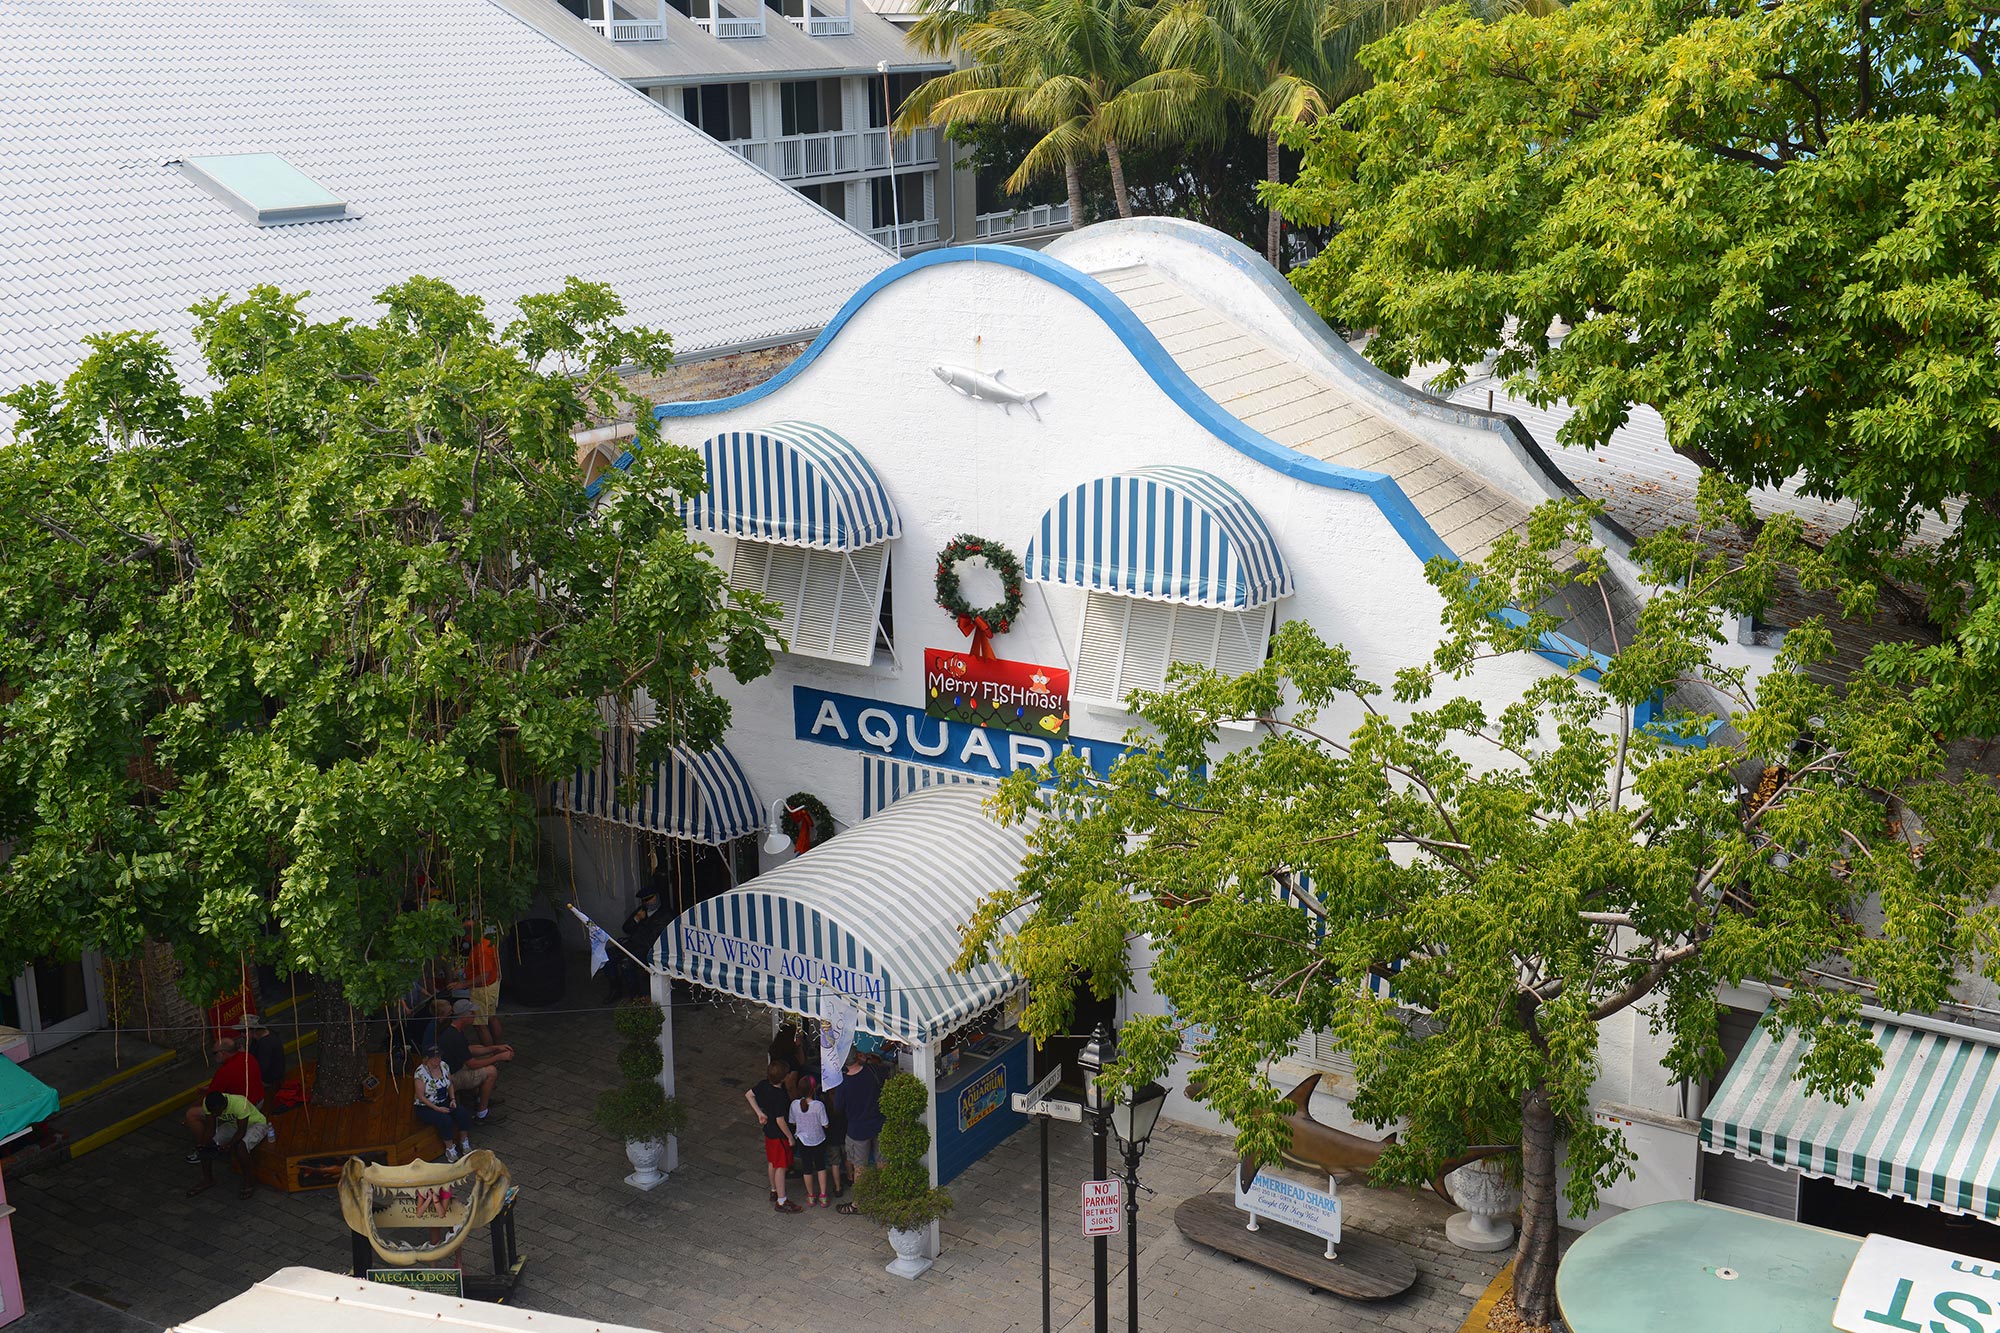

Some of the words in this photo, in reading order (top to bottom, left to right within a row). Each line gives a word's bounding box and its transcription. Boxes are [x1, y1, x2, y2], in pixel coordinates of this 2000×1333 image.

[928, 671, 980, 697] Merry
[982, 681, 1063, 711] FISHmas!
[811, 700, 1190, 798] AQUARU
[684, 927, 718, 957] KEY
[721, 937, 772, 971] WEST
[779, 953, 881, 1003] AQUARIUM
[981, 1070, 998, 1084] WEST
[961, 1072, 1005, 1112] AQUARIUM
[967, 1104, 995, 1126] TICKETS
[1040, 1102, 1049, 1112] St
[1094, 1183, 1109, 1195] NO
[1253, 1174, 1305, 1201] MMERHEAD
[1306, 1191, 1337, 1213] SHARK
[1085, 1194, 1118, 1207] PARKING
[1258, 1195, 1278, 1209] Caught
[1278, 1201, 1290, 1213] Off
[1290, 1205, 1305, 1219] Key
[1304, 1211, 1319, 1223] West
[1085, 1207, 1118, 1216] BETWEEN
[1091, 1216, 1113, 1225] SIGNS
[374, 1272, 456, 1283] MEGALODON
